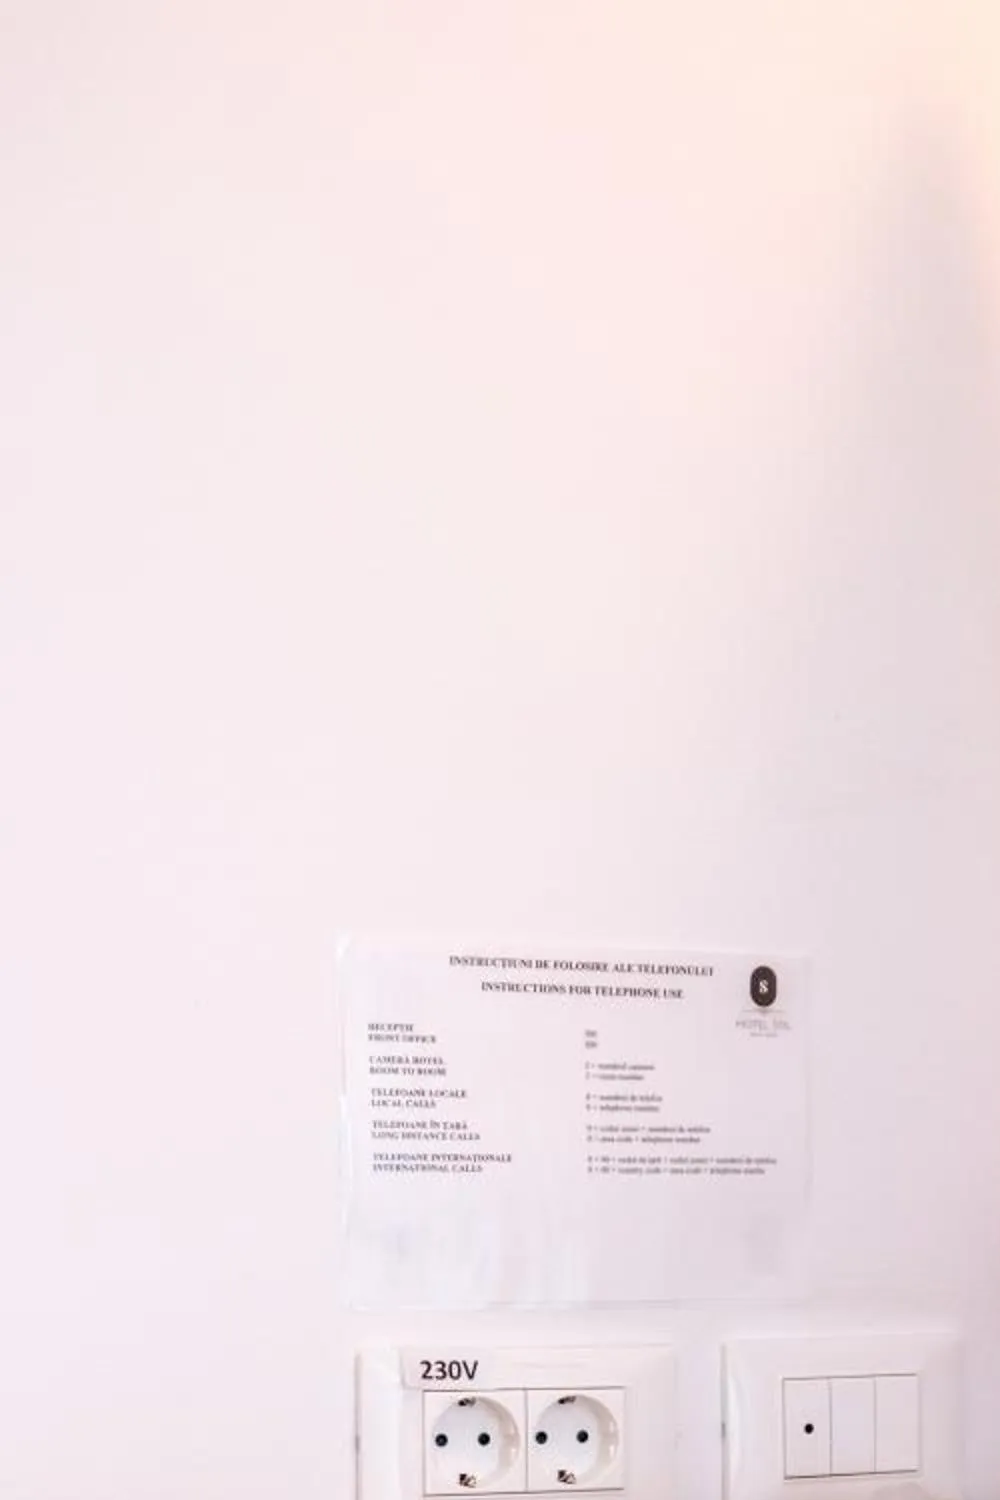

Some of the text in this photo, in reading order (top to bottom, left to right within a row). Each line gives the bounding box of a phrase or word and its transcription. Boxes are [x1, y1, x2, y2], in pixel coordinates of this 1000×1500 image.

[535, 959, 550, 969] DE
[553, 960, 609, 973] FOLOSIRE
[613, 963, 632, 974] ALE
[480, 981, 684, 1000] INSTRUCTIONS FOR TELEPHONE USE
[420, 1359, 479, 1381] 230V
